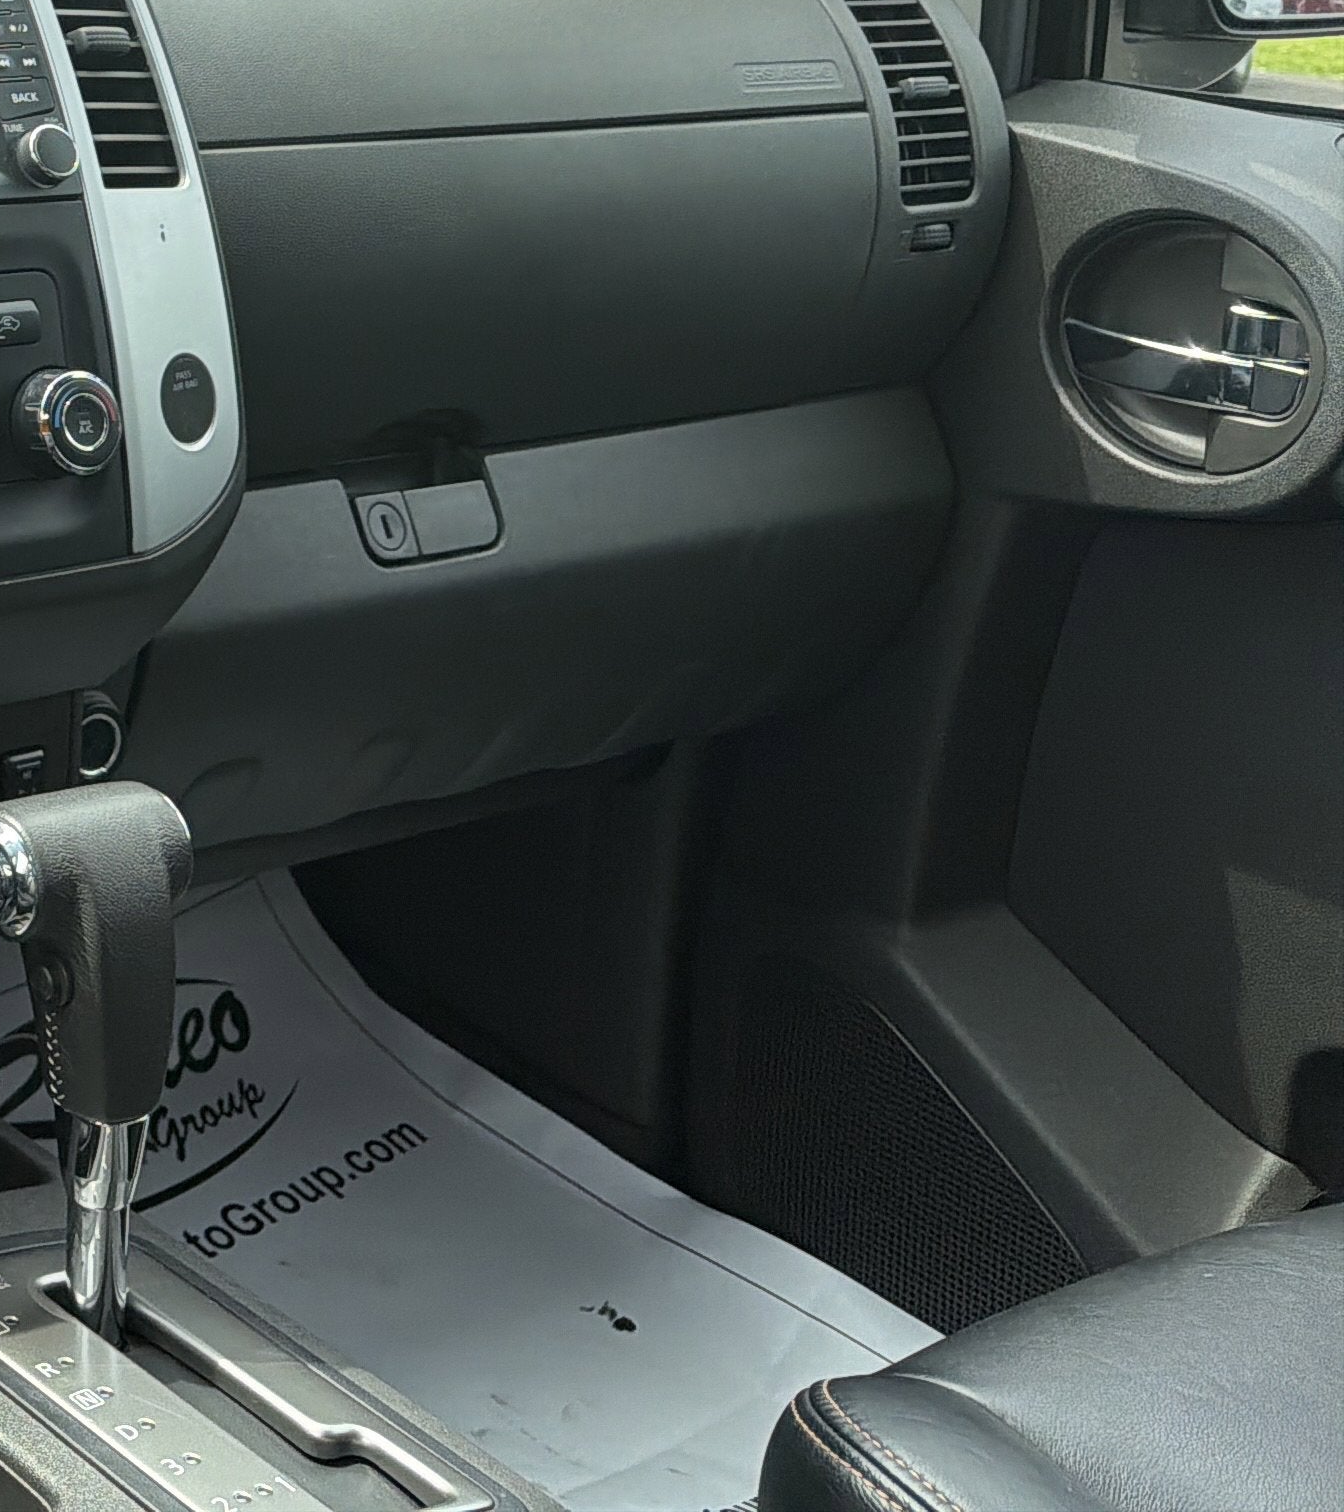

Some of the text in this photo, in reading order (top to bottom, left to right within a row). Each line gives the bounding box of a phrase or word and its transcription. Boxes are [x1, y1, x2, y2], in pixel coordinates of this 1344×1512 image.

[11, 92, 39, 103] BACK
[0, 123, 25, 133] TUNE
[148, 1078, 265, 1162] Group
[183, 1119, 429, 1259] toGroup.com
[35, 1362, 60, 1379] R
[80, 1390, 99, 1407] N
[115, 1424, 140, 1442] D
[160, 1458, 186, 1476] 3
[274, 1475, 298, 1493] 1
[211, 1497, 237, 1512] 2
